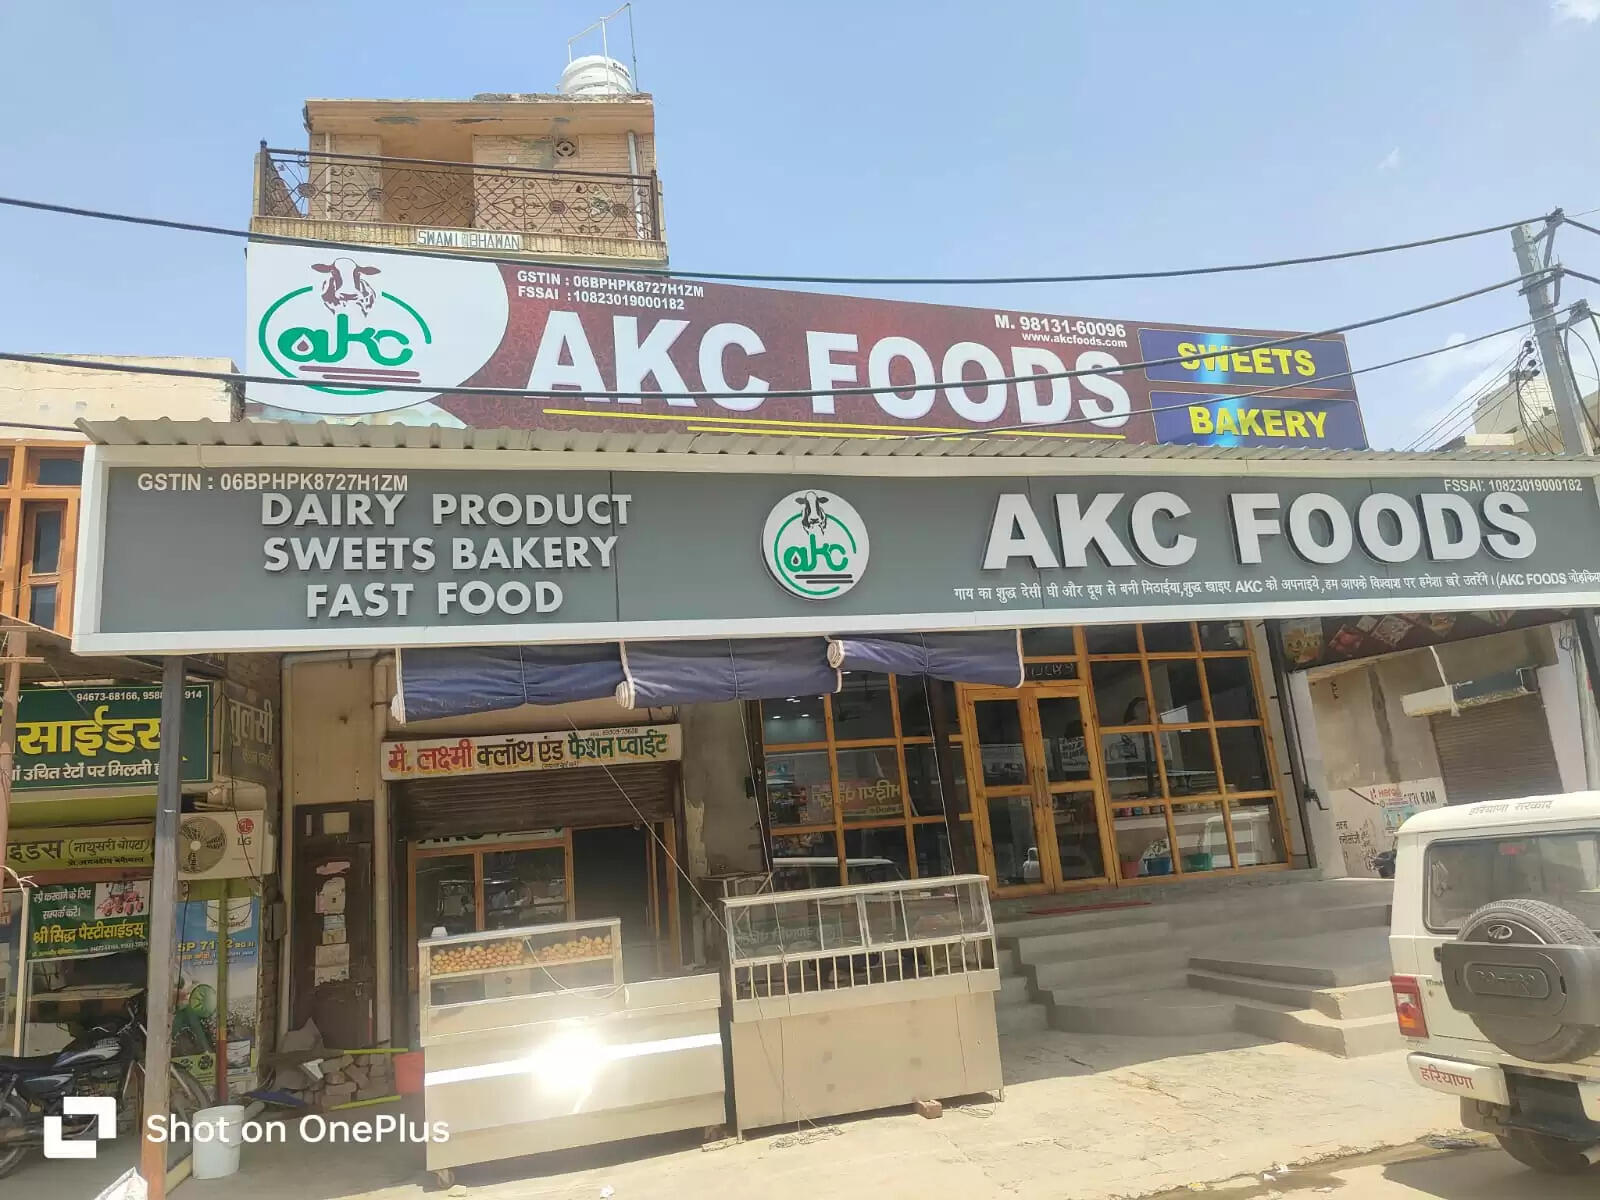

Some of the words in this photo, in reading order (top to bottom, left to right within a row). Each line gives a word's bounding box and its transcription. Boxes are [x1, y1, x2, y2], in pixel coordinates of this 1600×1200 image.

[418, 230, 458, 246] SWAMI
[469, 233, 520, 249] BHAWAN
[517, 270, 561, 285] GSTIN
[573, 275, 704, 297] 06BPHPK8727H1ZM
[517, 285, 559, 300] FSSAI
[994, 314, 1015, 330] M.
[1020, 316, 1126, 338] 98131-60096
[1022, 332, 1128, 349] www.akcfoods.com
[524, 309, 770, 411] AKC
[805, 329, 1132, 428] FOODS
[1177, 342, 1316, 377] SWEETS
[1188, 405, 1327, 439] BAKERY
[137, 472, 200, 491] GSTIN
[220, 473, 408, 492] 06BPHPK8727H1ZM
[1488, 478, 1583, 492] 10823019000182
[260, 493, 406, 527] DAIRY
[432, 493, 632, 527] PRODUCT
[980, 491, 1198, 571] AKC
[1230, 491, 1539, 566] FOODS
[263, 536, 436, 572] SWEETS
[452, 535, 619, 571] BAKERY
[953, 587, 974, 600] गाय
[978, 587, 992, 600] का
[1020, 582, 1041, 598] देसी
[1062, 580, 1083, 598] और
[1087, 584, 1103, 600] दूध
[1106, 579, 1117, 595] से
[1120, 579, 1140, 595] बनी
[1235, 580, 1263, 593] AKC
[1265, 576, 1278, 592] को
[1341, 574, 1367, 590] आपके
[1403, 576, 1416, 589] पर
[1419, 573, 1442, 588] हमेशा
[1527, 571, 1567, 587] FOODS
[305, 583, 414, 619] FAST
[437, 580, 564, 617] FOOD
[537, 735, 564, 762] एंड
[23, 763, 60, 781] उचित
[87, 764, 107, 779] पर
[107, 759, 152, 778] मिलती
[237, 835, 252, 847] LG
[1419, 1065, 1475, 1090] हरियाणा
